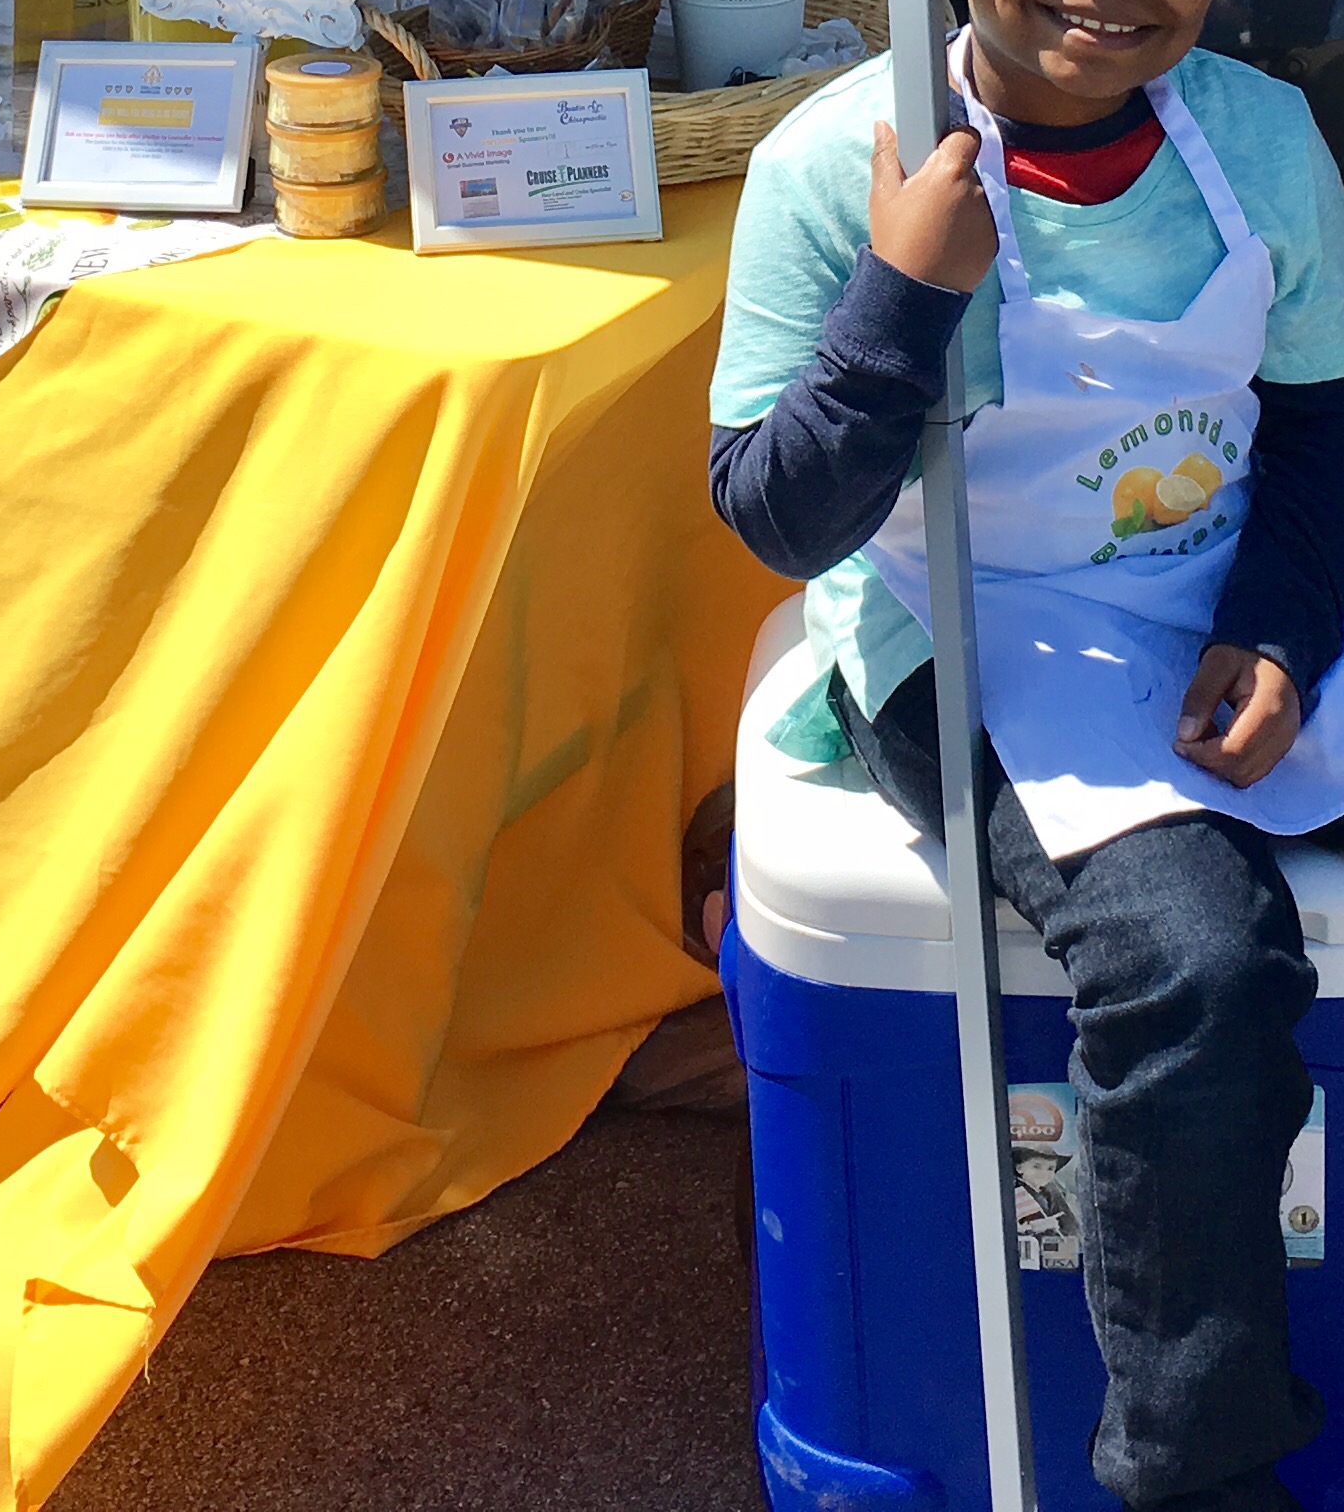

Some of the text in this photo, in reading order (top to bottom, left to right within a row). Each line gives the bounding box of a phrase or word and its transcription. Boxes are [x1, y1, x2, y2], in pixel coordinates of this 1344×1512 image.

[491, 128, 512, 136] Thank
[456, 149, 513, 161] A Vivid Image
[1076, 409, 1238, 492] Lemonade
[1045, 1257, 1077, 1268] USA
